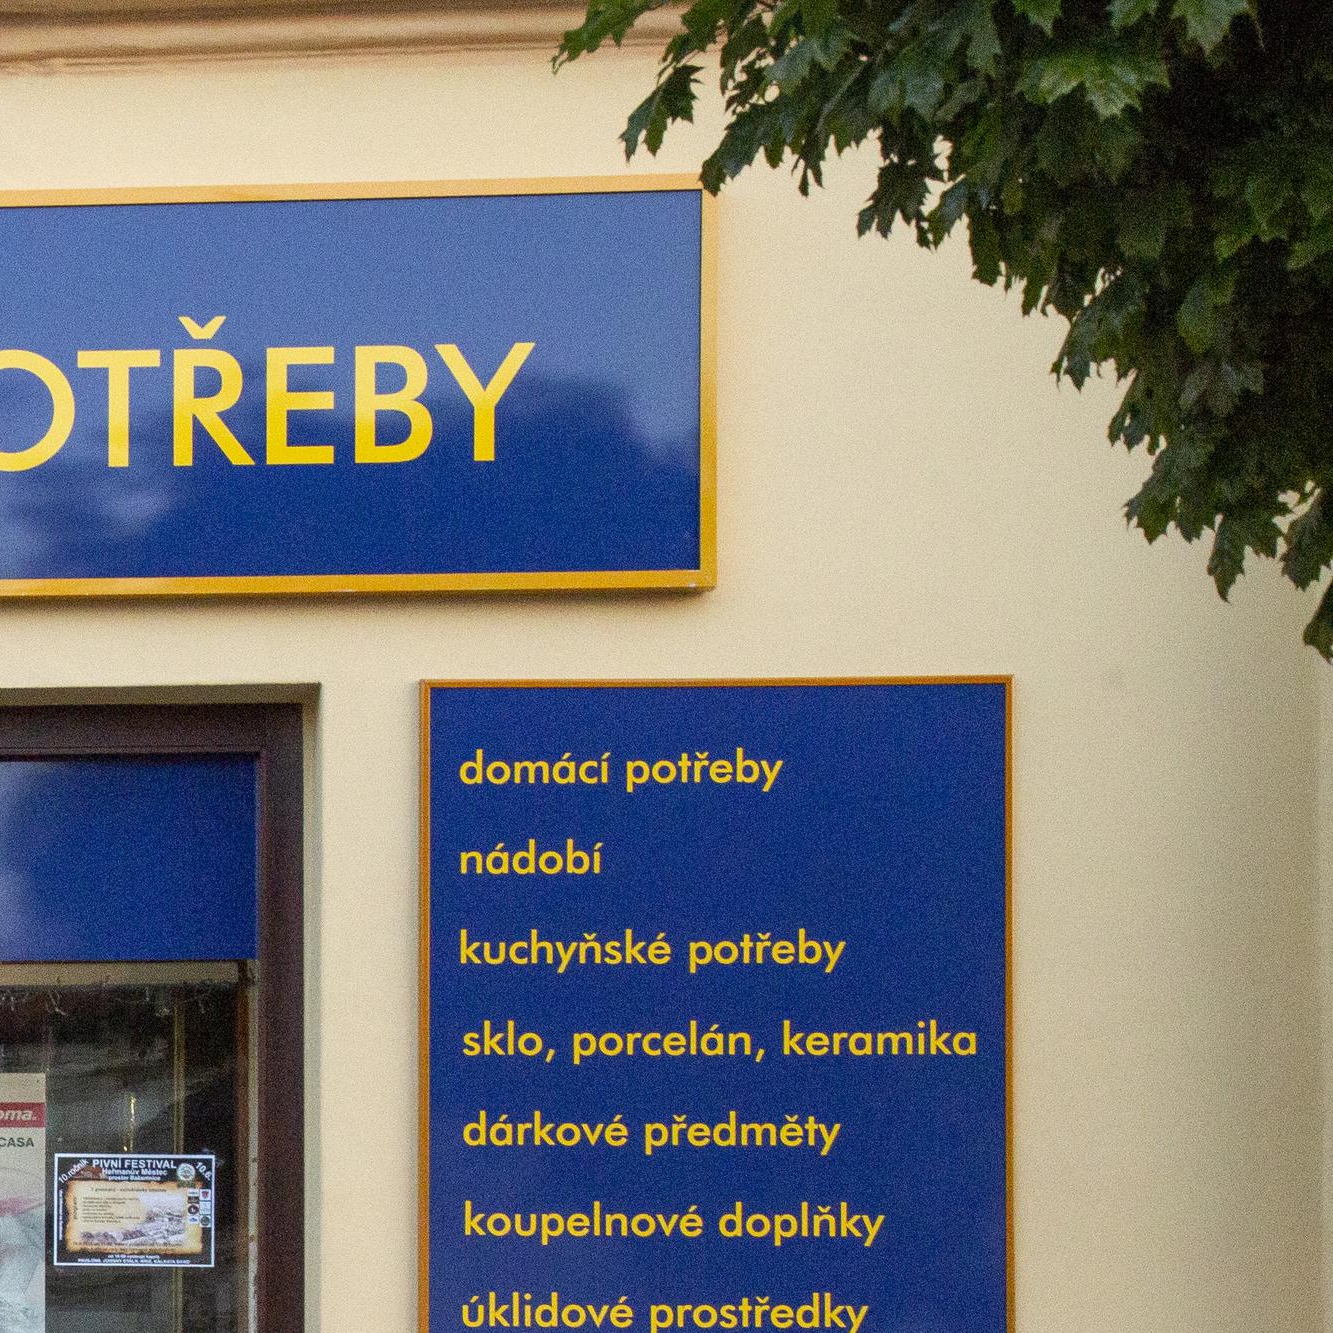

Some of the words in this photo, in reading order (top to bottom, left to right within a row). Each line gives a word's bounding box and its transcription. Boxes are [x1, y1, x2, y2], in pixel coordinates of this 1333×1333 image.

[460, 749, 611, 786] domácí
[627, 748, 785, 794] potřeby
[461, 839, 603, 876] nádobí
[460, 929, 673, 975] kuchyňské
[690, 929, 847, 975] potřeby
[463, 1020, 557, 1064] sklo,
[574, 1020, 766, 1066] porcelán,
[784, 1020, 978, 1057] keramika
[463, 1110, 630, 1148] dárkové
[645, 1111, 842, 1157] předměty
[92, 1157, 122, 1169] PIVNÍ
[124, 1159, 177, 1169] FESTIVAL
[464, 1200, 705, 1247] koupelnové
[719, 1202, 886, 1248] doplňky
[462, 1292, 635, 1330] úklidové
